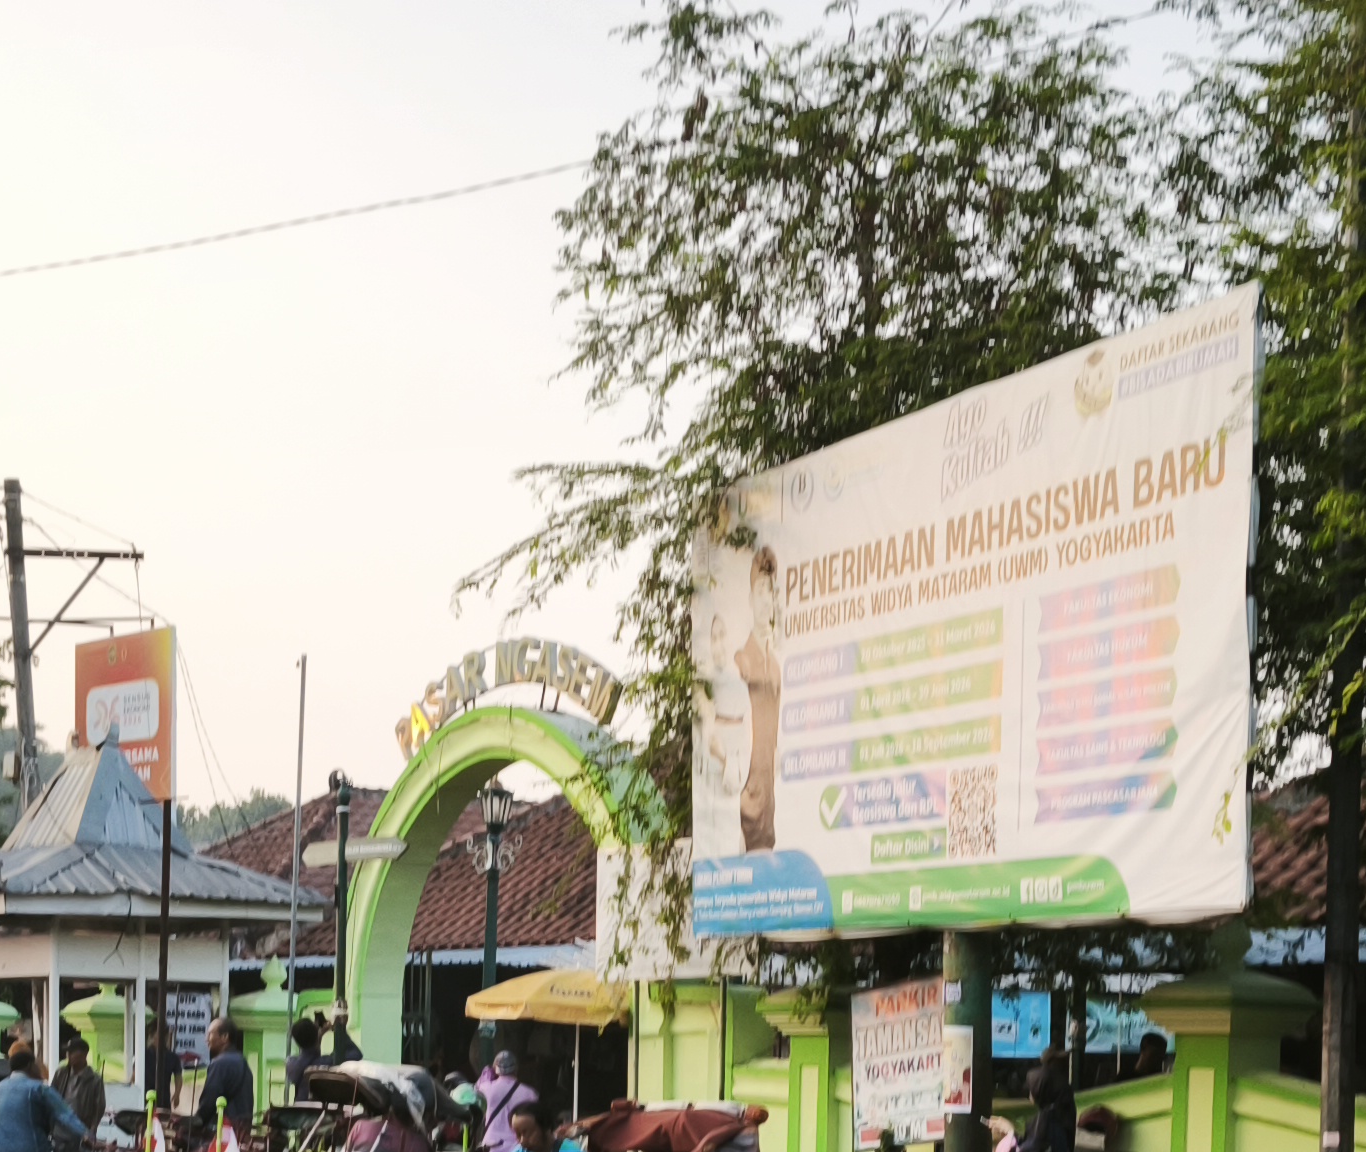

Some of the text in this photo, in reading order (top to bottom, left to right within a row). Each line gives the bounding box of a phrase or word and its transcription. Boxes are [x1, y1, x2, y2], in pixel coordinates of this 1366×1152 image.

[1120, 312, 1240, 373] DAFTAR SEKARANG
[785, 435, 1227, 607] PENERIMAAN MAHASISWA BARU
[785, 511, 1176, 638] UNIVERSITAS WIDYA MATARAM (UWM) YOGYAKARTA
[394, 636, 624, 761] PASAR NGASEM
[873, 836, 903, 858] Daftar
[875, 984, 939, 1017] PARKIR
[856, 1012, 944, 1061] TAMANSA
[865, 1053, 943, 1080] YOGYAKART
